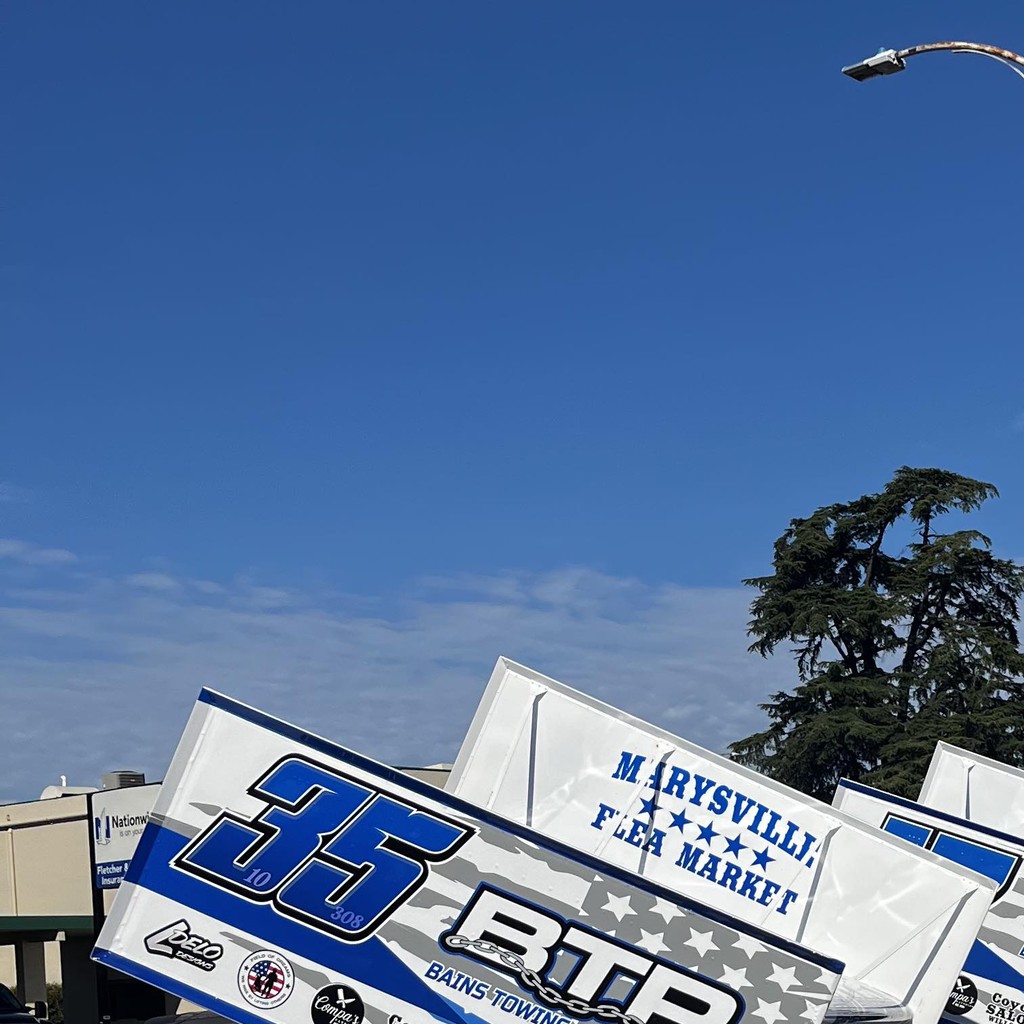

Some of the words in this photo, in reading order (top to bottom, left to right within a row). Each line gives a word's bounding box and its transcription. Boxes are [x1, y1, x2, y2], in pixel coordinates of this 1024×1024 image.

[169, 753, 481, 945] 35
[97, 864, 123, 875] Fletcher
[243, 868, 271, 887] 10
[675, 842, 798, 915] MARKET
[331, 906, 364, 929] 308
[176, 950, 214, 969] DESIGNS
[424, 961, 490, 1000] BAINS
[314, 995, 360, 1024] Compa's
